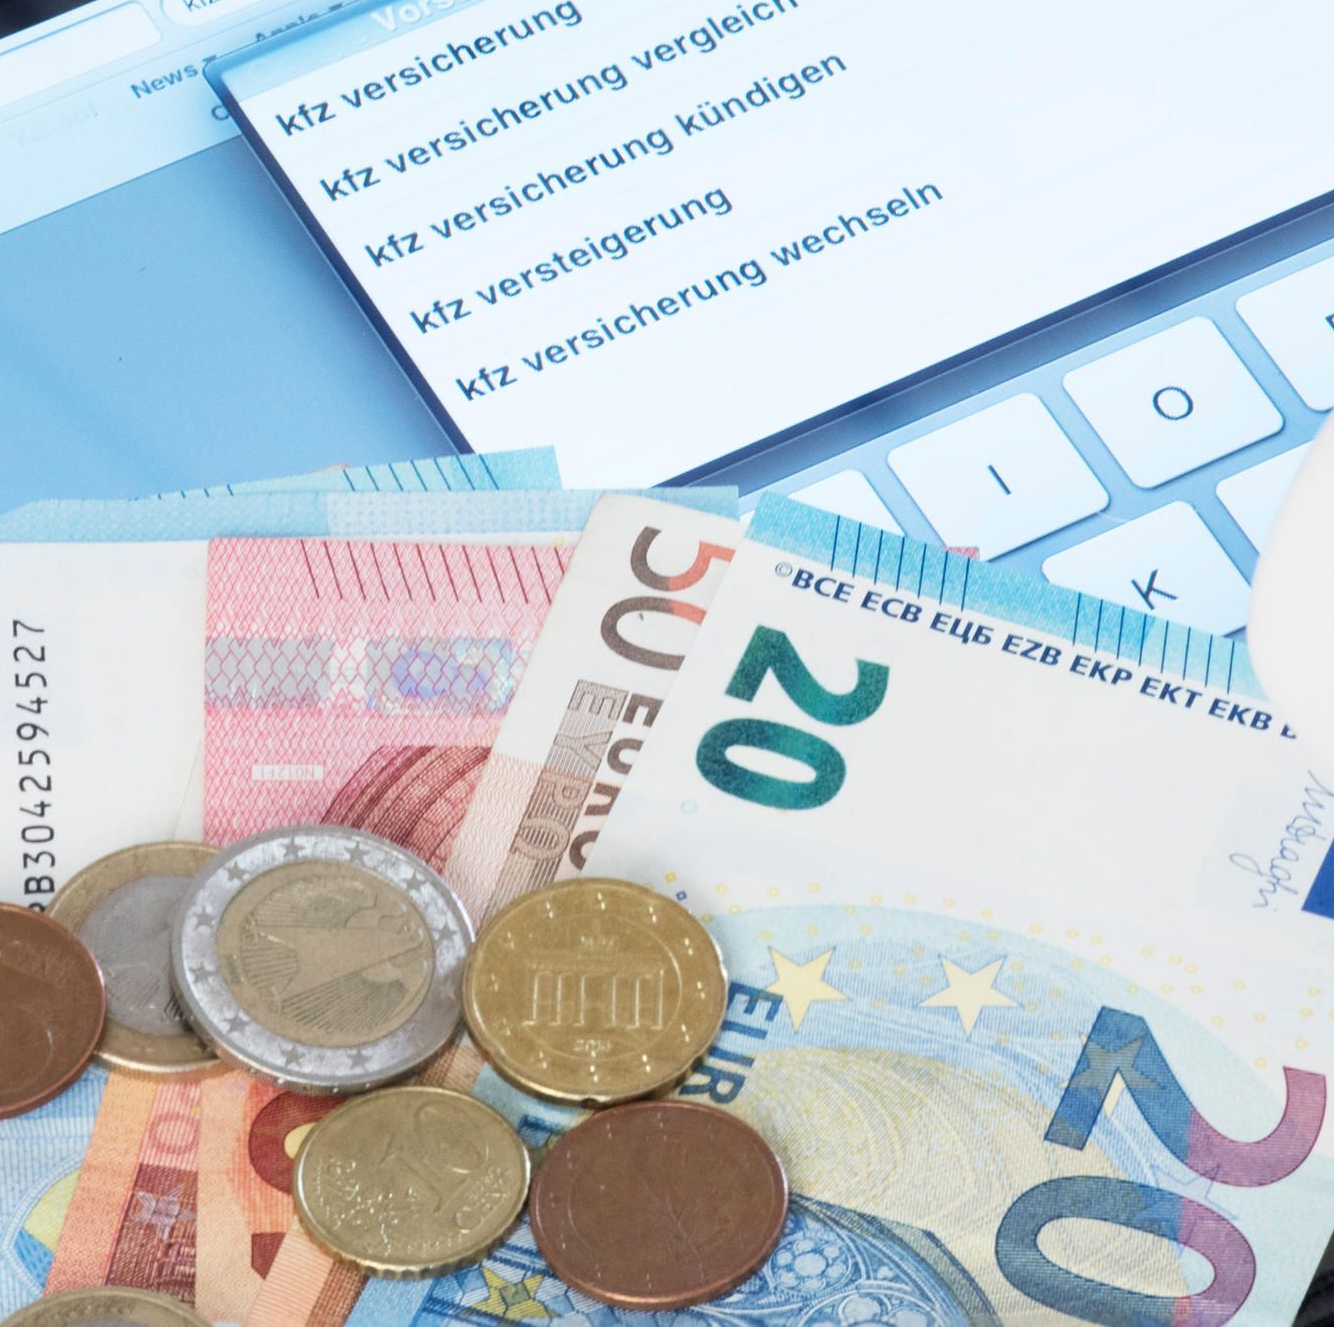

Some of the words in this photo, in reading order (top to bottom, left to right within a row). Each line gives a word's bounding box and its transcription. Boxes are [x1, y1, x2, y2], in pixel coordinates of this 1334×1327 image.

[130, 63, 199, 101] News
[275, 96, 337, 139] kfz
[319, 161, 381, 204] kfz
[385, 61, 628, 176] versicherung
[364, 227, 425, 270] kfz
[430, 125, 675, 241] versicherung
[675, 49, 848, 138] kündigen
[409, 294, 473, 336] kfz
[476, 183, 735, 308] versteigerung
[455, 361, 519, 403] kfz
[521, 256, 768, 374] versicherung
[769, 180, 945, 269] wechseln
[1151, 385, 1195, 422] O
[986, 463, 1012, 496] I
[599, 525, 736, 671] 50
[1130, 568, 1178, 610] K
[696, 624, 890, 811] 20
[859, 591, 925, 625] ECB
[1001, 633, 1064, 667] EZB
[1068, 653, 1134, 688] EKP
[1138, 674, 1204, 712] EKT
[1207, 695, 1274, 733] EKB
[995, 1004, 1328, 1327] 20
